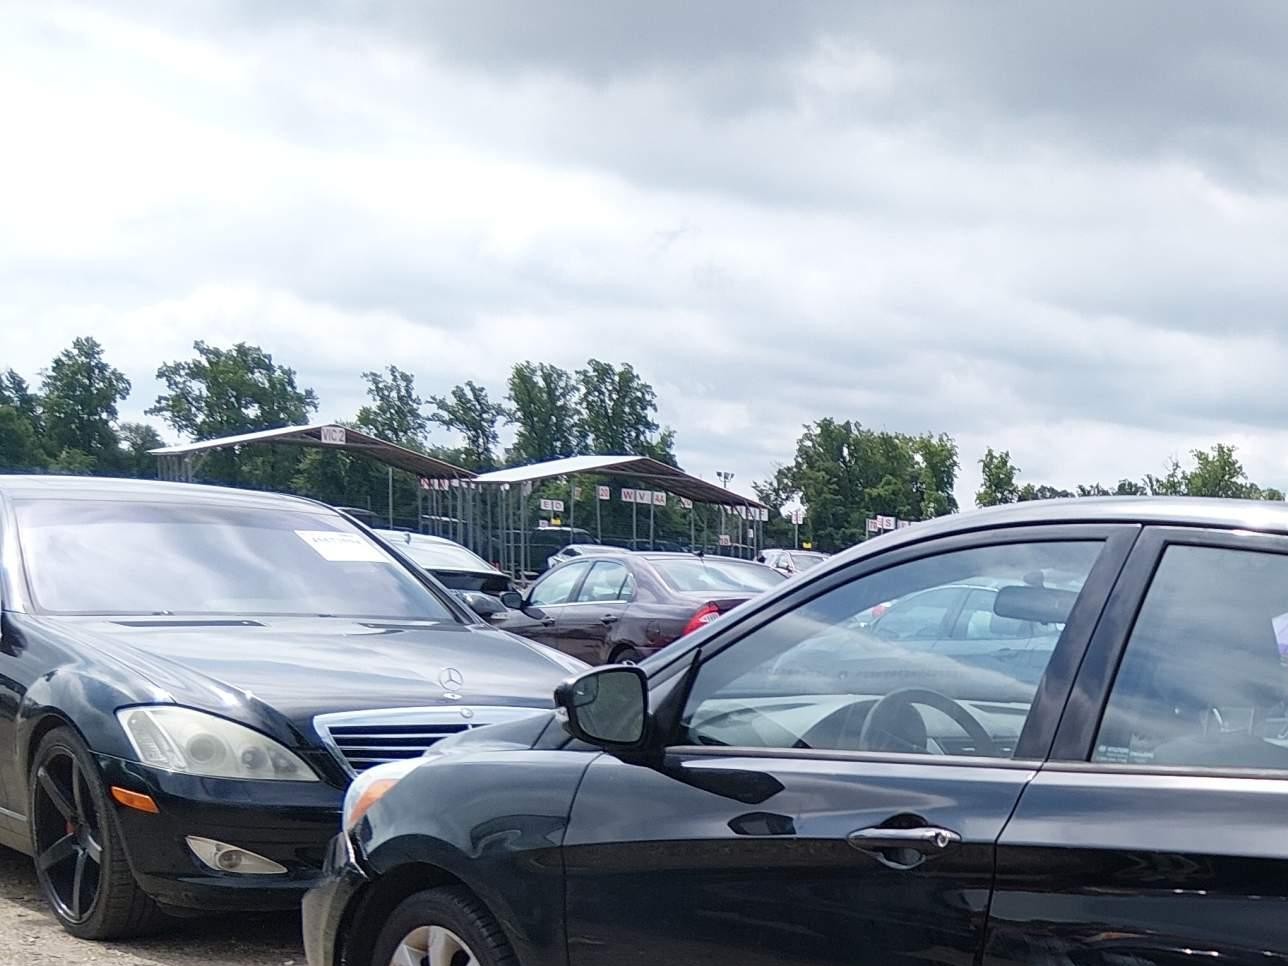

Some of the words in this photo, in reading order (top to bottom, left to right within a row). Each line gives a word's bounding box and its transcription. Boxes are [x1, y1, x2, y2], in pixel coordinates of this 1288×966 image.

[322, 428, 337, 442] VIC
[339, 429, 345, 442] 2
[623, 490, 633, 500] W
[638, 491, 645, 501] V
[885, 518, 892, 527] S
